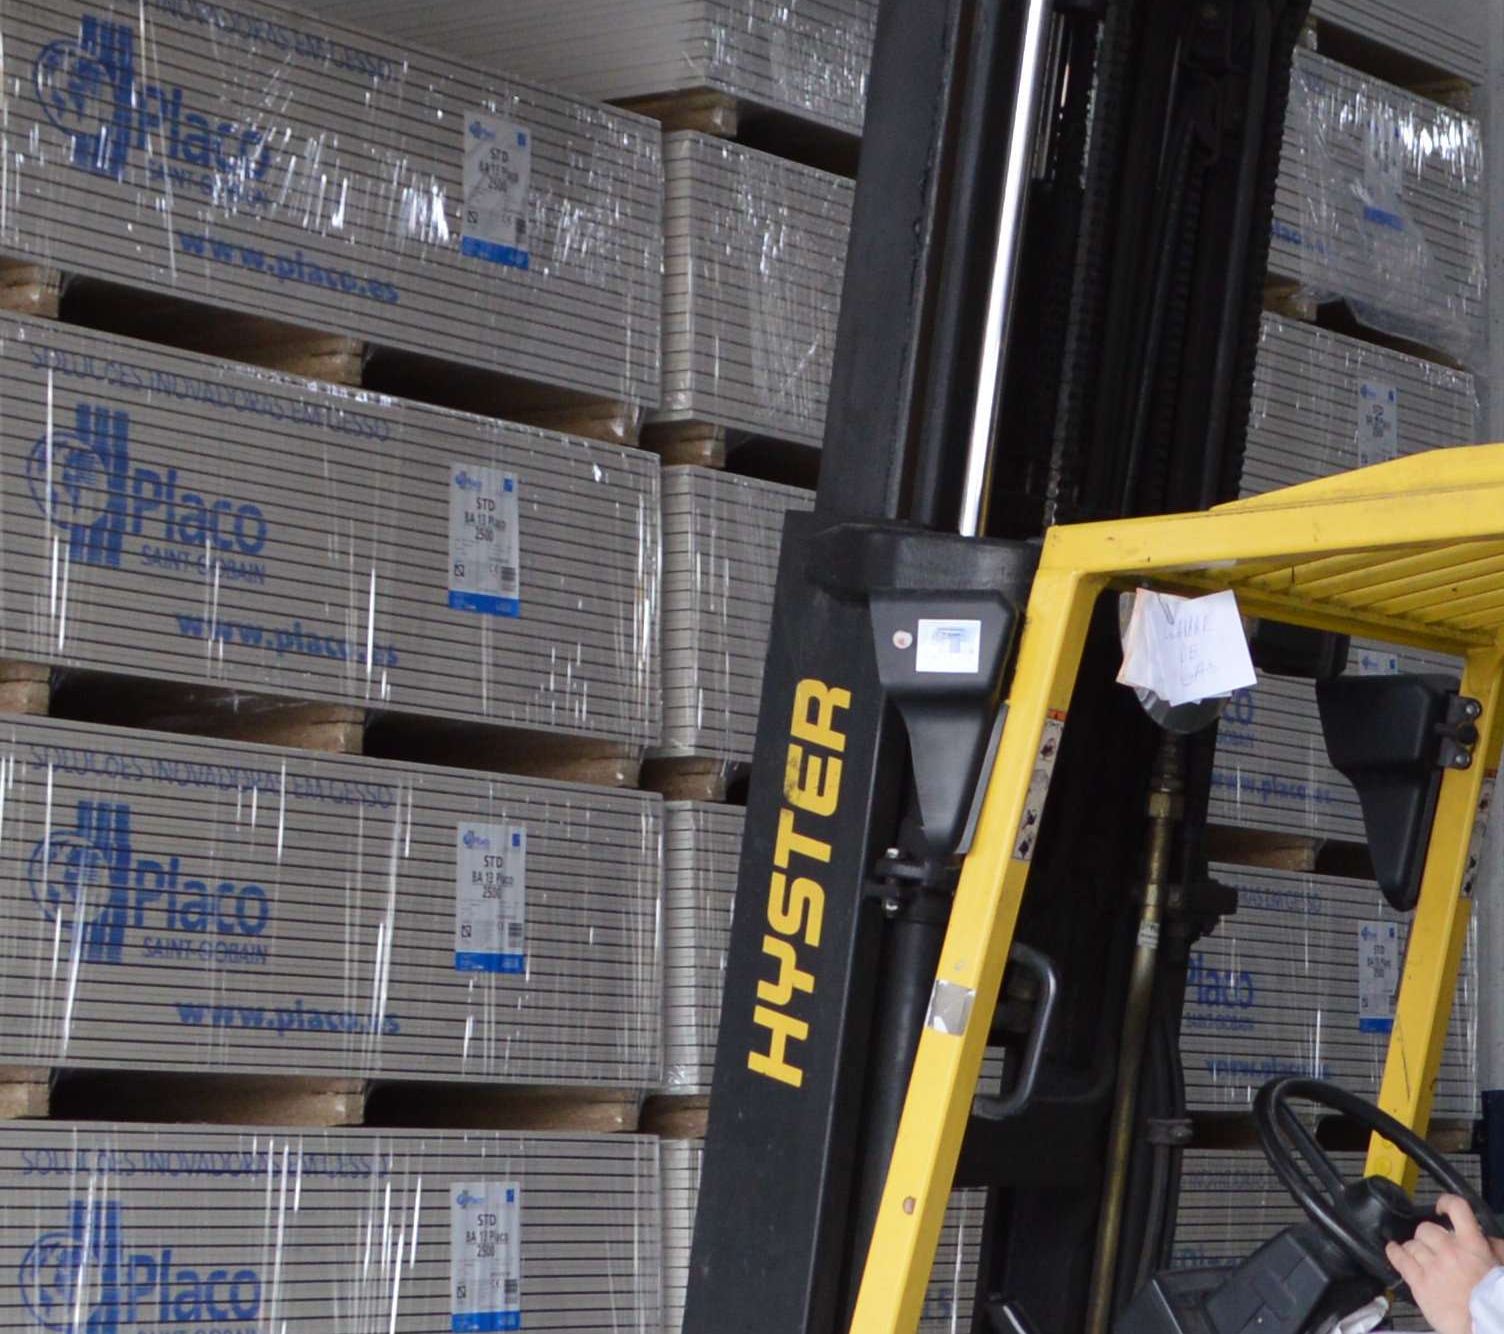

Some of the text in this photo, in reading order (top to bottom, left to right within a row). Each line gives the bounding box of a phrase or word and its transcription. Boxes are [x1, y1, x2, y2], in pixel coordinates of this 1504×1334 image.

[136, 84, 271, 182] Placo
[489, 147, 510, 164] STD
[176, 228, 400, 305] www.placo.es
[149, 369, 286, 422] INOVADORAS
[329, 410, 390, 442] GESSO
[132, 467, 267, 556] Placo
[476, 496, 496, 513] STD
[175, 608, 400, 667] www.placo.es
[151, 758, 394, 811] INOVADORAS EM GESSO
[484, 854, 504, 869] STD
[745, 676, 853, 1089] HYSTER
[134, 857, 270, 938] Placo
[141, 935, 270, 966] SAINT-GOBAIN
[177, 997, 402, 1038] www.placo.es
[466, 1230, 477, 1244] BA
[479, 1230, 488, 1244] 13
[477, 1214, 497, 1228] STD
[126, 1248, 263, 1323] Placo
